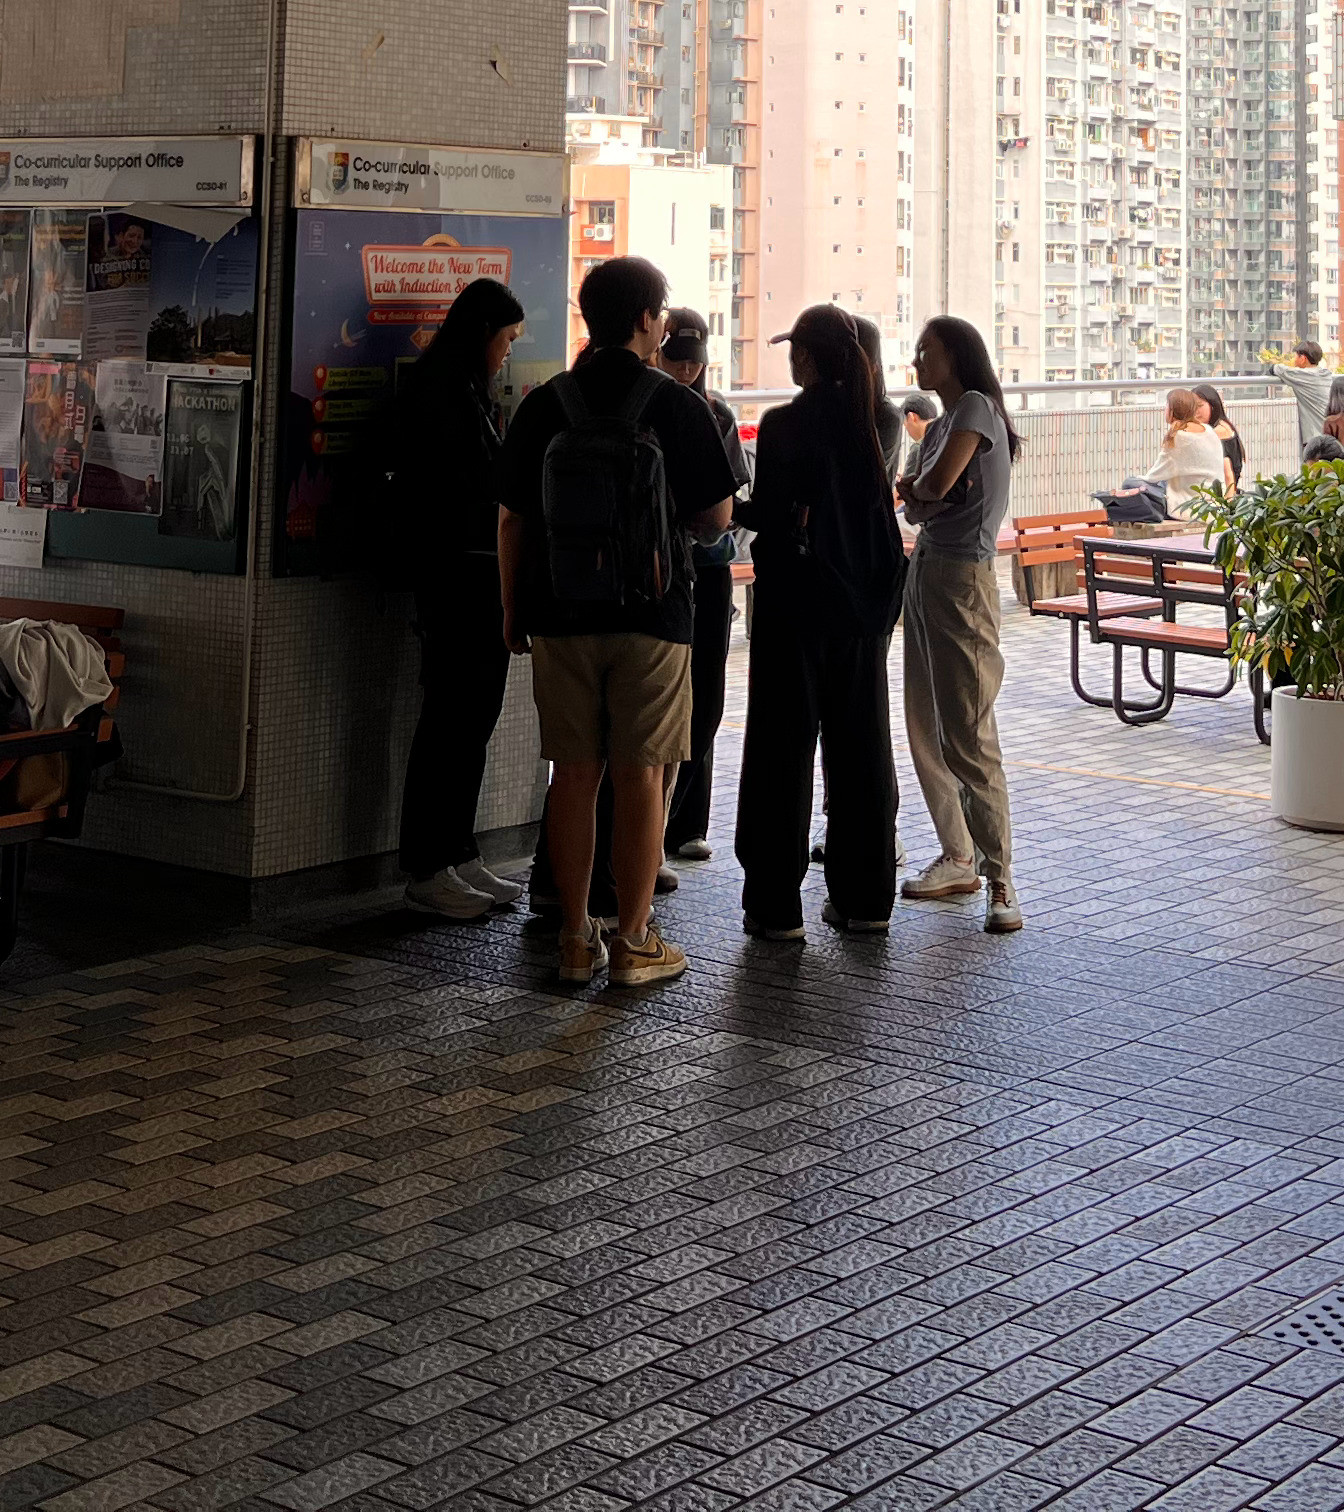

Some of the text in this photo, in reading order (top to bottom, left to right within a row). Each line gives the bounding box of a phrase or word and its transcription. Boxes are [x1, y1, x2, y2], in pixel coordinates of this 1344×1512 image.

[14, 152, 184, 171] Co-curricular Support Office
[353, 157, 516, 180] Co-curricular Support Office
[14, 175, 68, 189] The Registry
[353, 178, 410, 194] The Registry
[370, 254, 504, 275] Welcome the New Term
[375, 277, 469, 294] with Induction Sp
